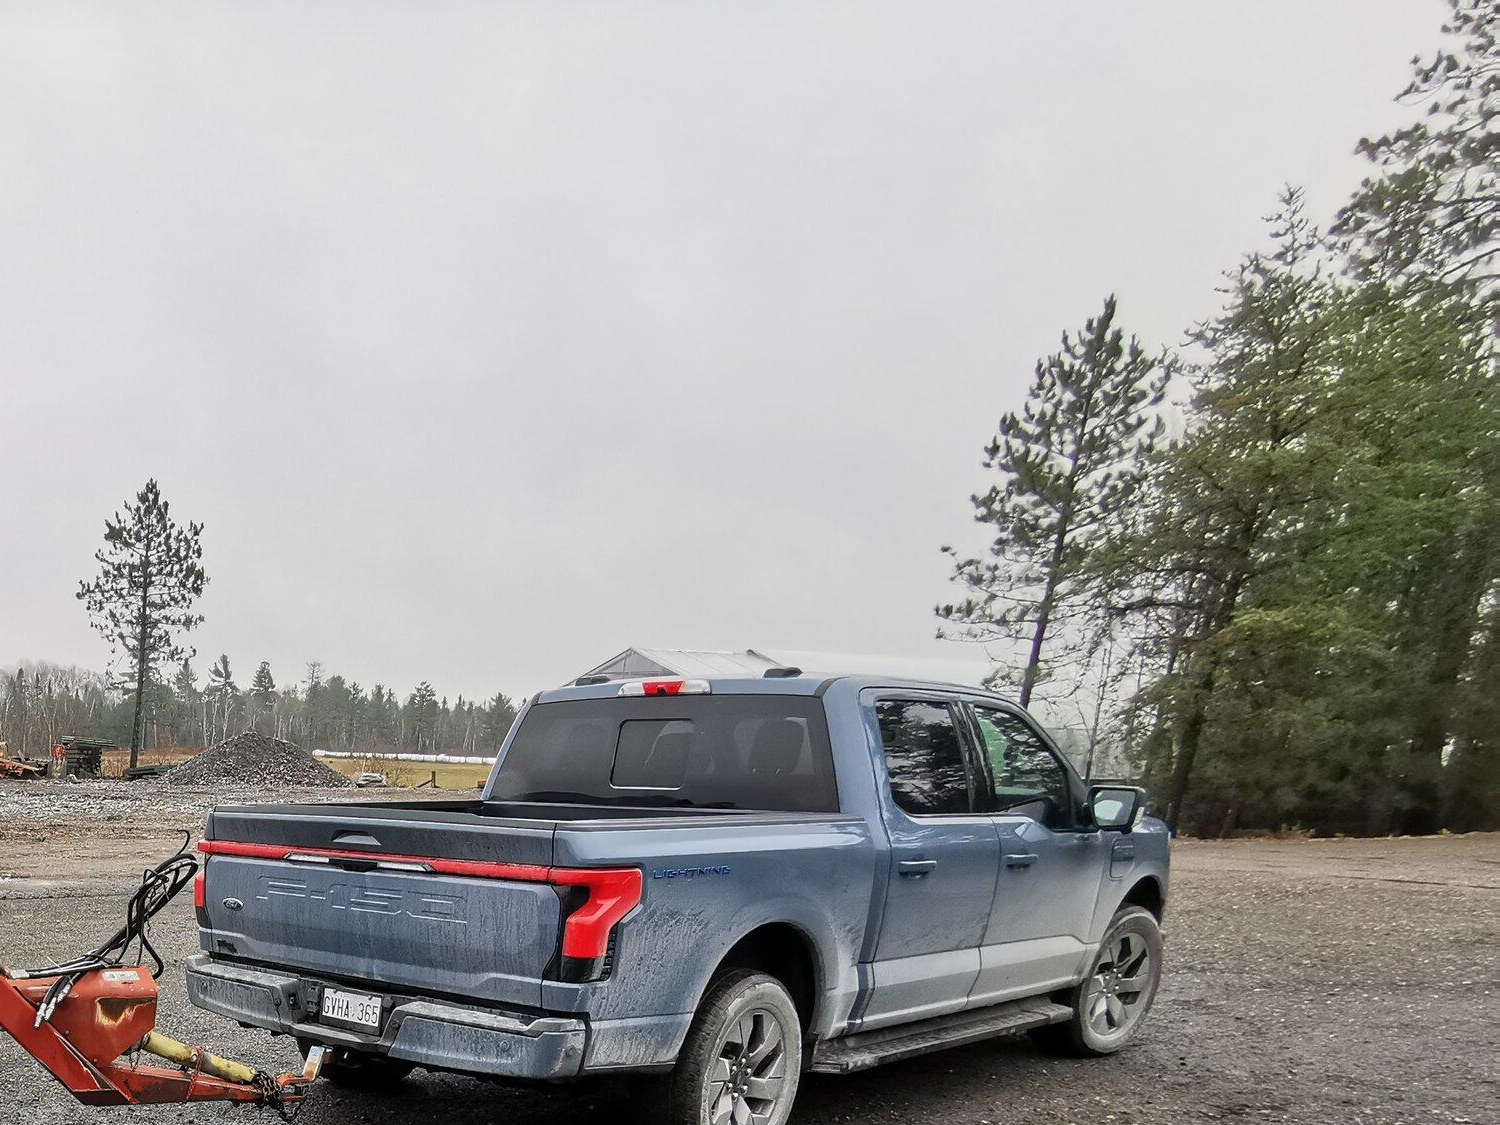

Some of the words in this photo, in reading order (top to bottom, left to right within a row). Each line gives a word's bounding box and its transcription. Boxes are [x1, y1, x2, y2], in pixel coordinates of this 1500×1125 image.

[653, 865, 731, 880] LIGHTNING
[256, 876, 468, 925] F-150
[357, 1002, 379, 1025] 365
